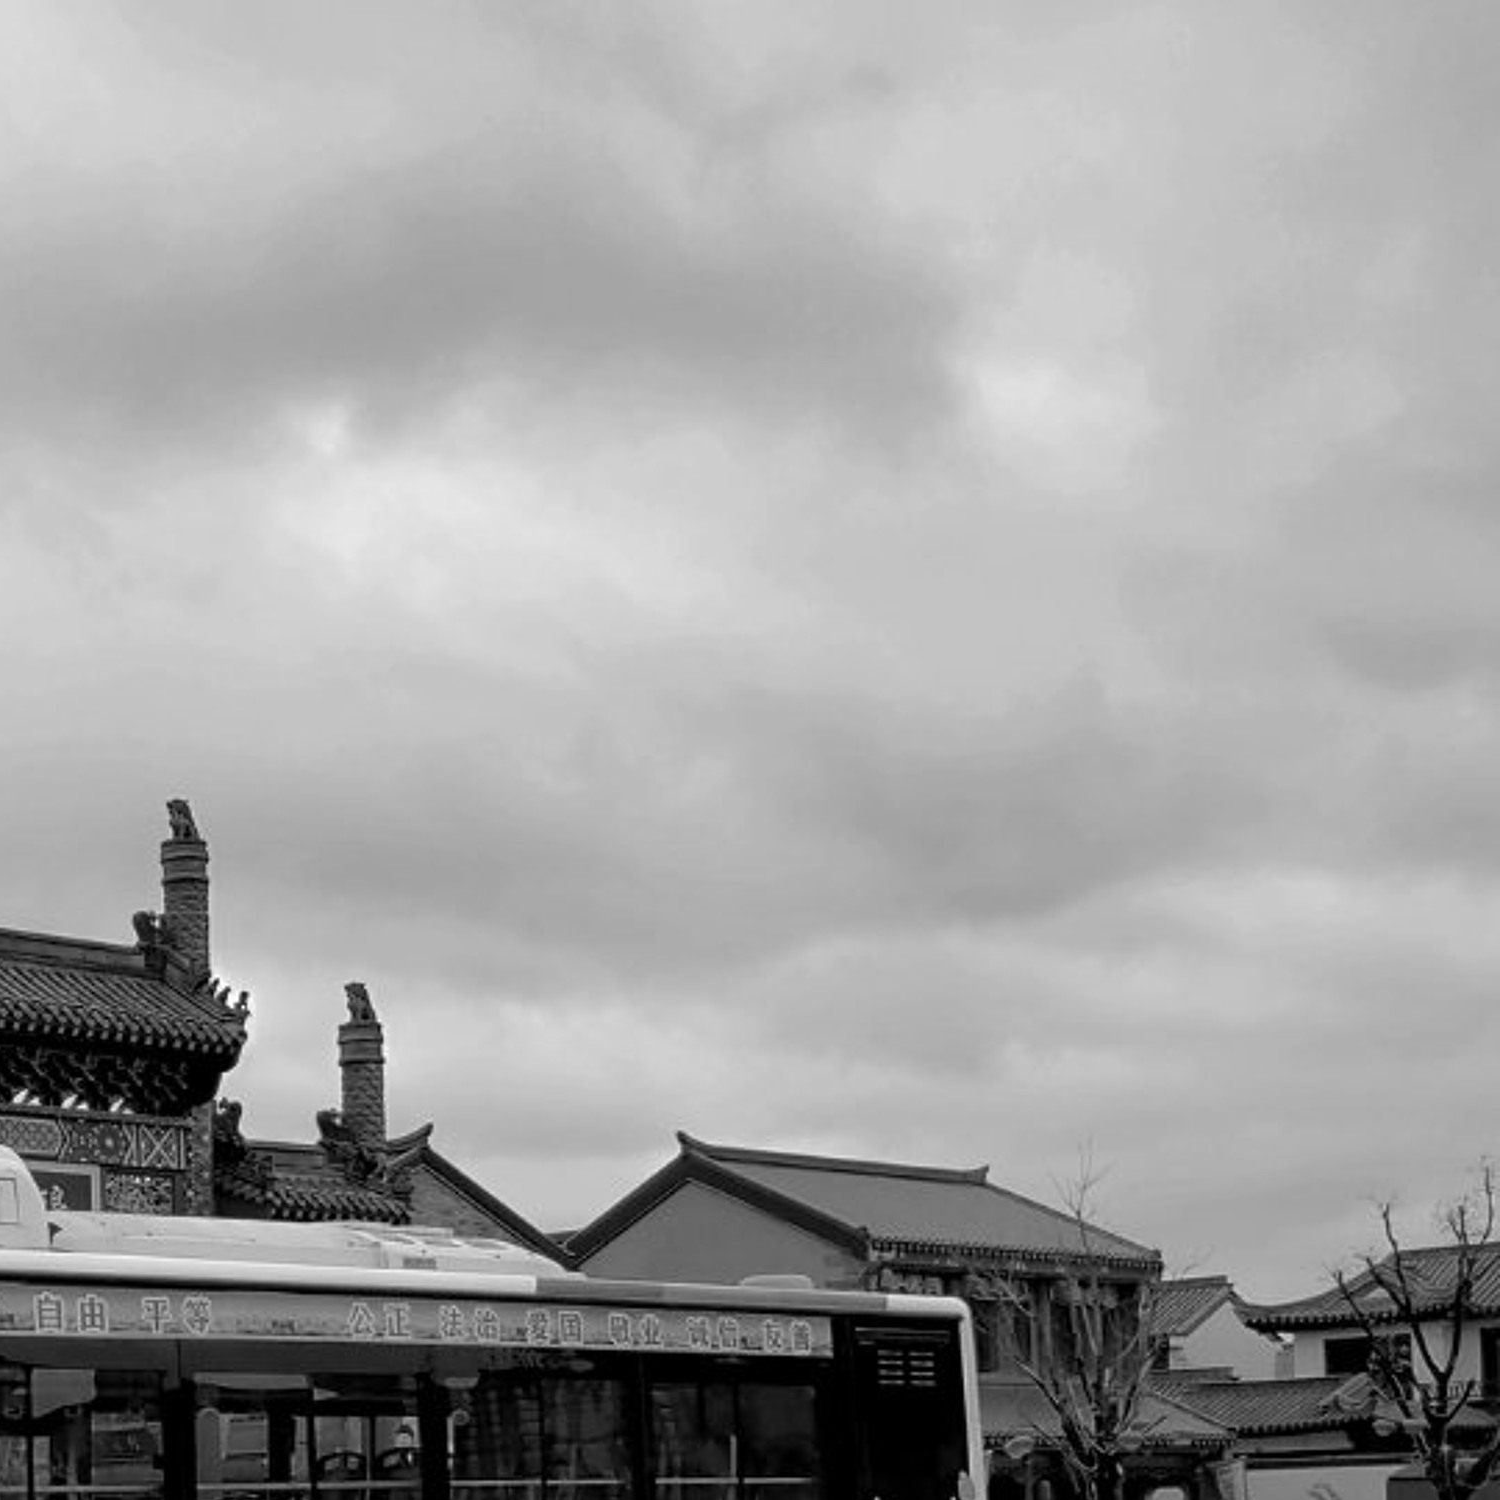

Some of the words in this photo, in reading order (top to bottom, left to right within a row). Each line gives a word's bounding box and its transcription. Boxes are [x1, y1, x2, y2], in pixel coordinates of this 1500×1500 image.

[33, 1292, 109, 1334] 自由
[141, 1291, 212, 1336] 平等
[347, 1302, 409, 1338] 公正
[440, 1304, 499, 1343] 法治
[527, 1310, 583, 1346] 爱国
[608, 1312, 663, 1348] 敬业
[687, 1314, 741, 1350] 诚信
[762, 1316, 812, 1354] 友善
